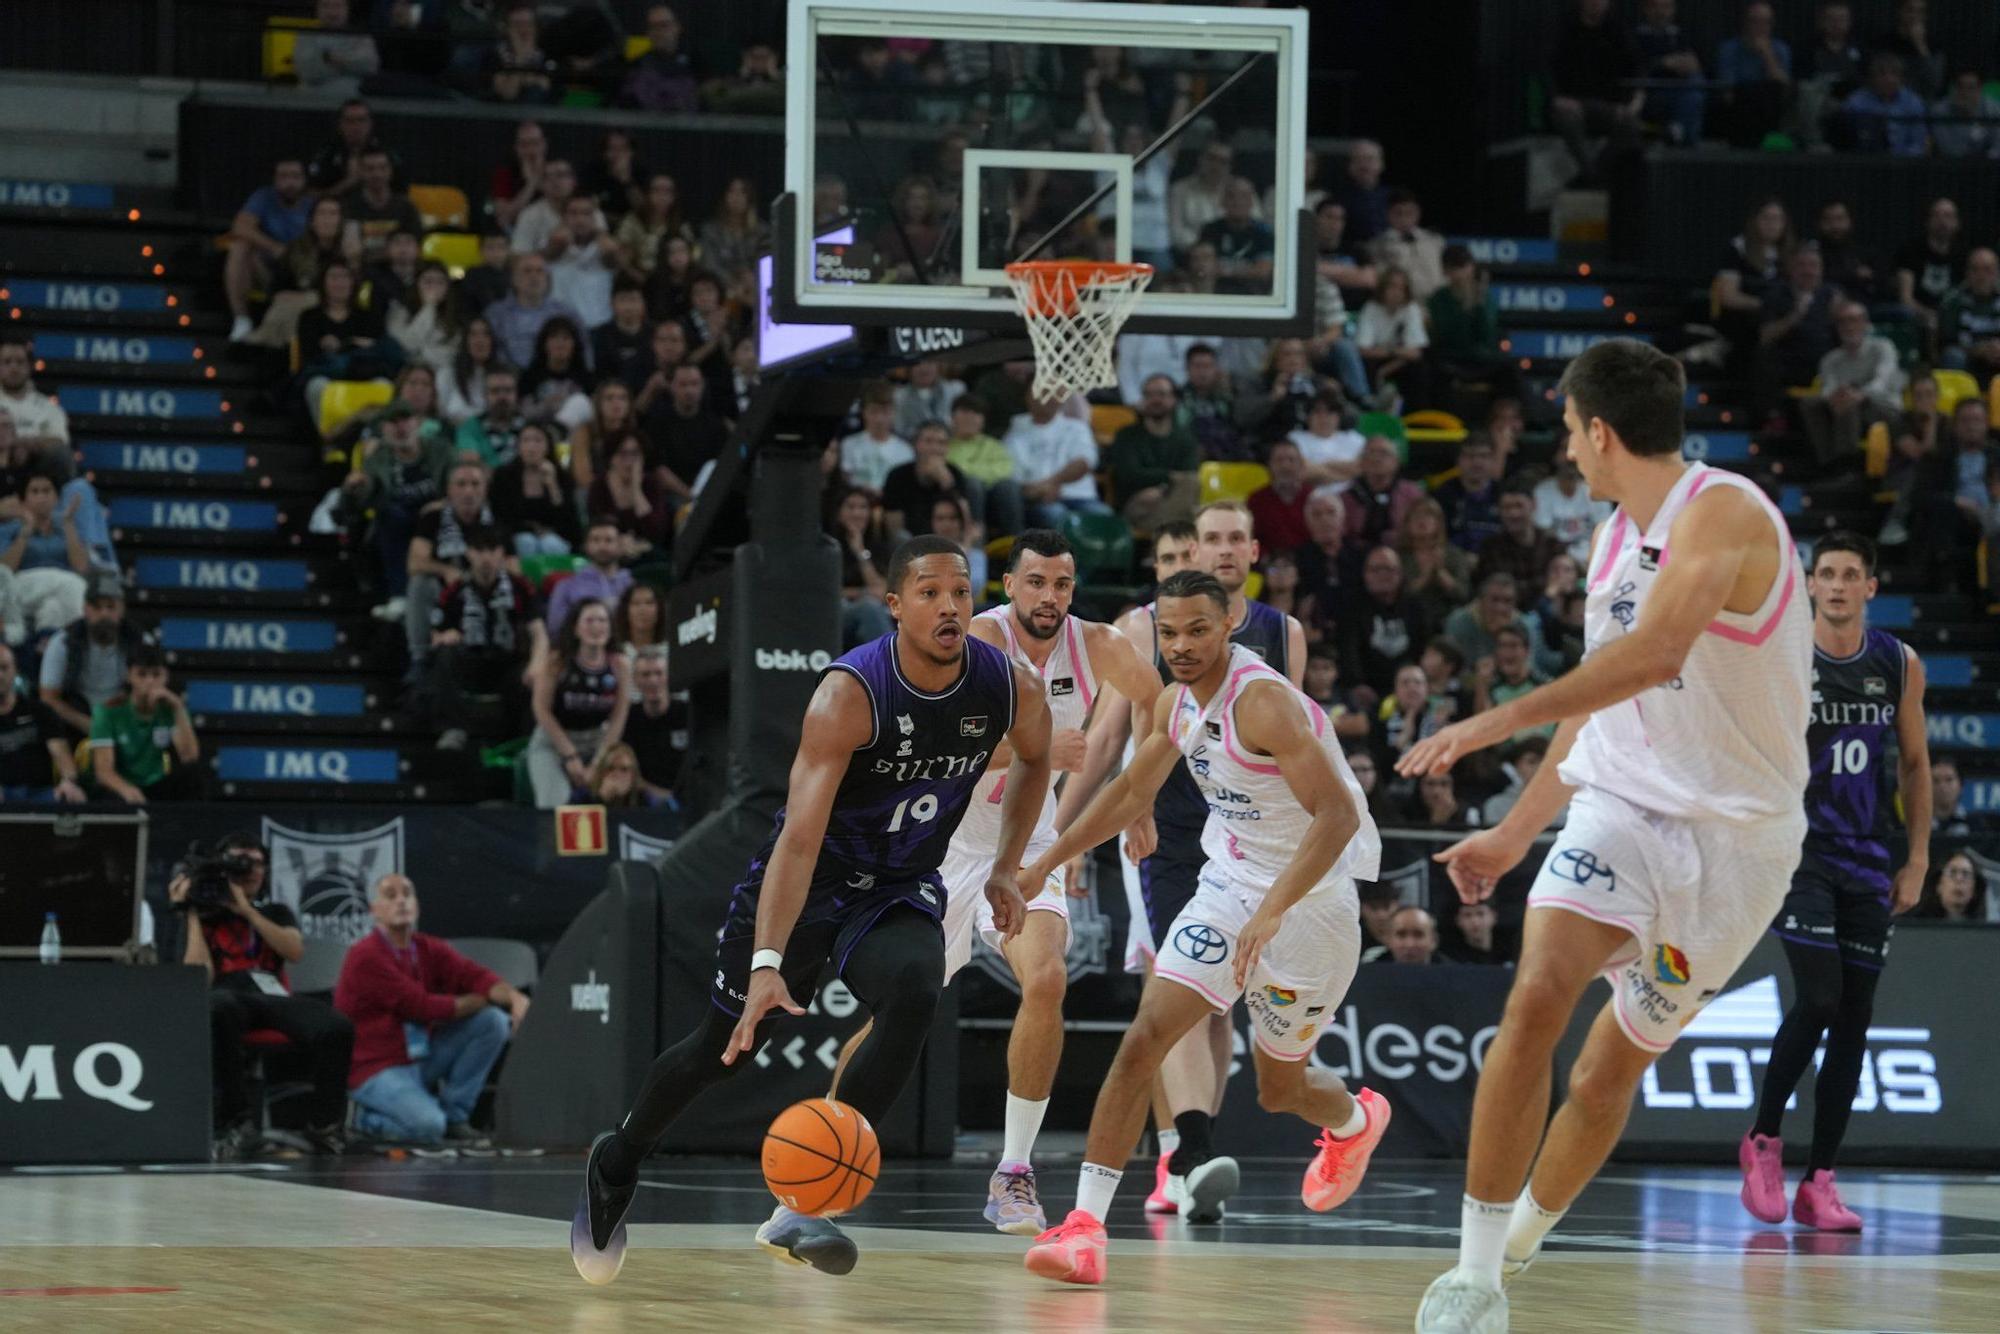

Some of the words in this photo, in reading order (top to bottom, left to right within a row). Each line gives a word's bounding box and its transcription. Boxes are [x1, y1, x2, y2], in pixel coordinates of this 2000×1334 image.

[100, 389, 176, 418] IMQ
[122, 445, 198, 474] IMQ
[152, 502, 230, 531] IMQ
[180, 560, 259, 591] IMQ
[206, 622, 286, 652] IMQ
[232, 685, 315, 716] IMQ
[265, 751, 350, 783] IMQ
[871, 750, 988, 781] surne
[1831, 739, 1869, 775] 10
[887, 793, 938, 833] 19
[0, 1041, 154, 1112] MQ
